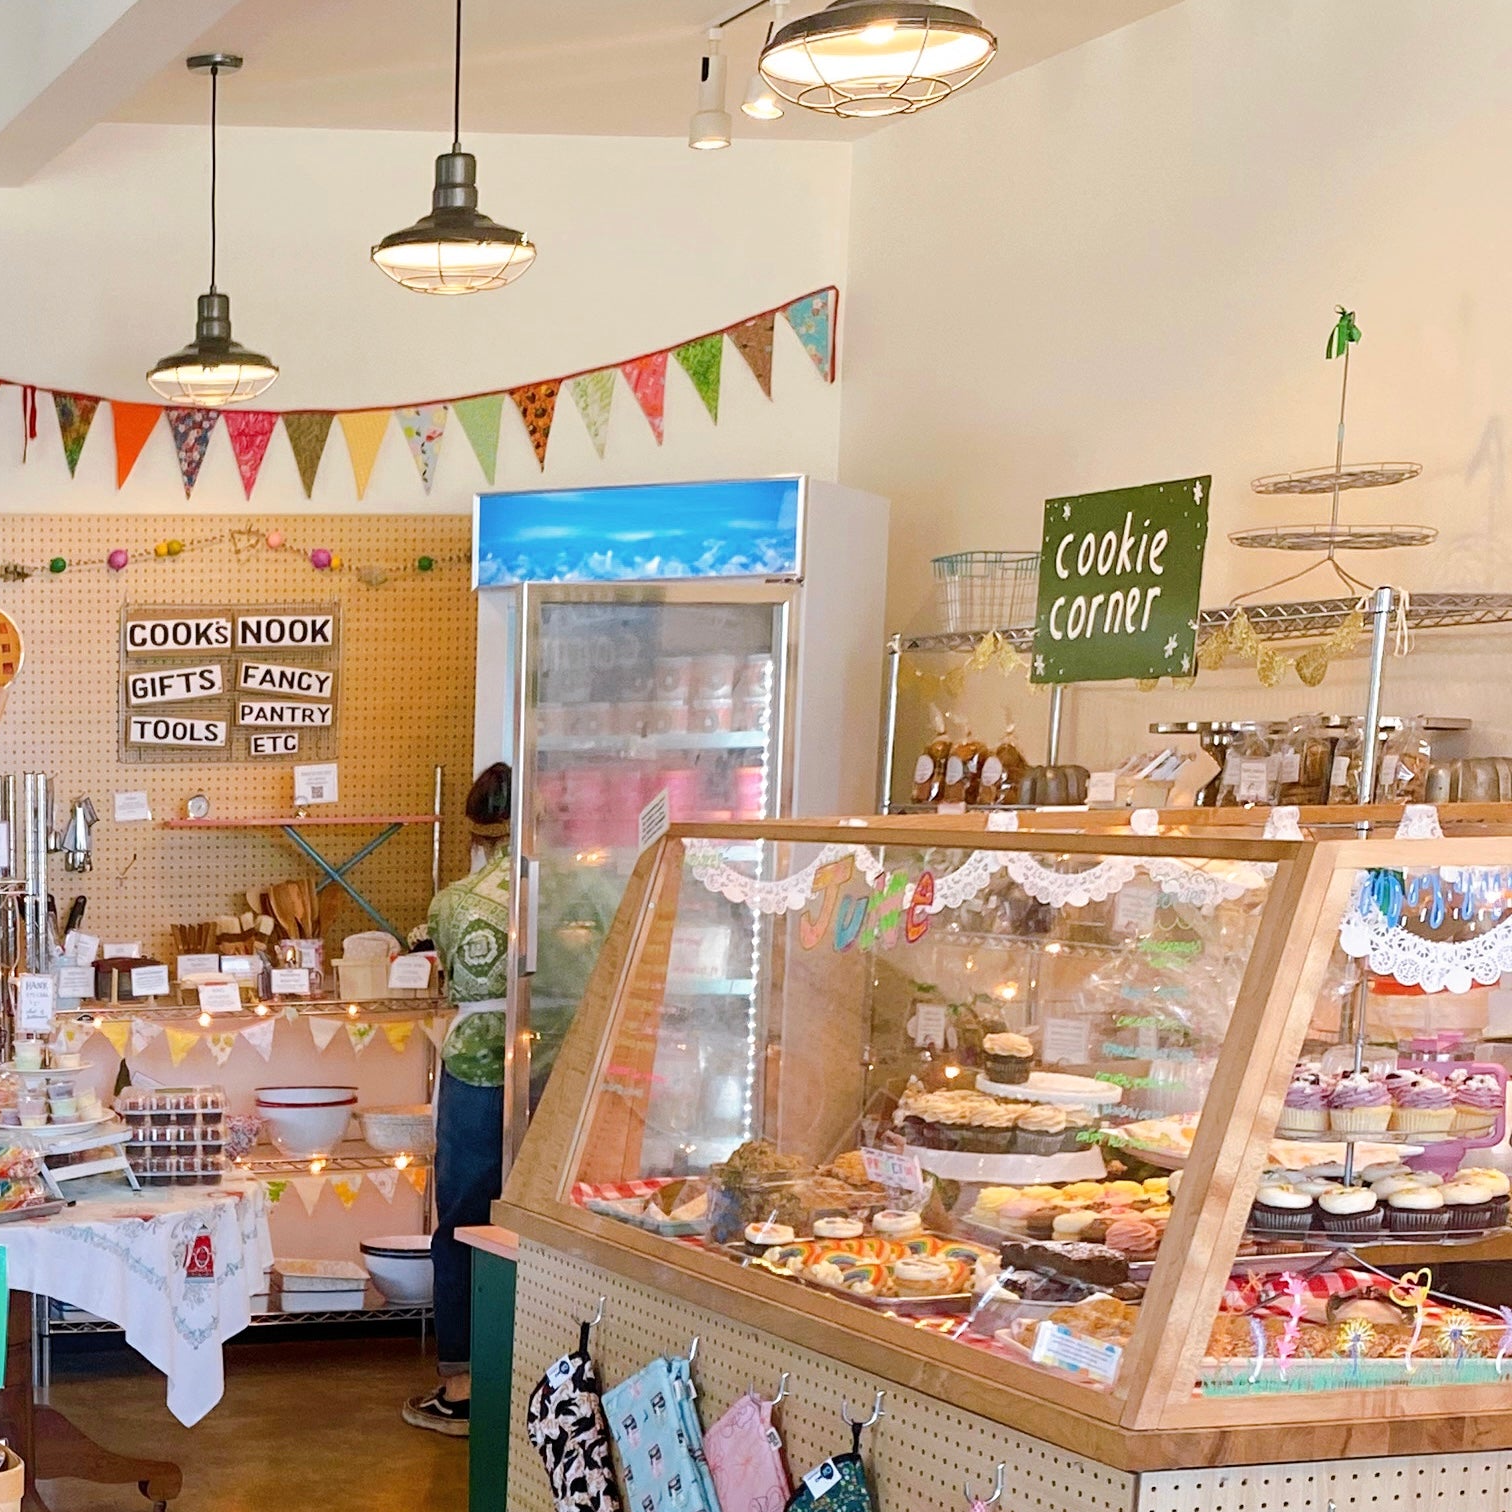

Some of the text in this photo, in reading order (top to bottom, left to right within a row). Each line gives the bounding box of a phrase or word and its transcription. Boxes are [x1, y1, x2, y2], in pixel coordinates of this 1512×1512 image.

[1055, 512, 1169, 580] cookie
[1049, 585, 1162, 641] corner
[240, 618, 331, 645] NOOK
[131, 669, 216, 700] GIFTS
[242, 665, 331, 694] FANCY
[240, 705, 331, 723] PANTRY
[133, 720, 220, 742] TOOLS
[253, 735, 297, 753] ETC
